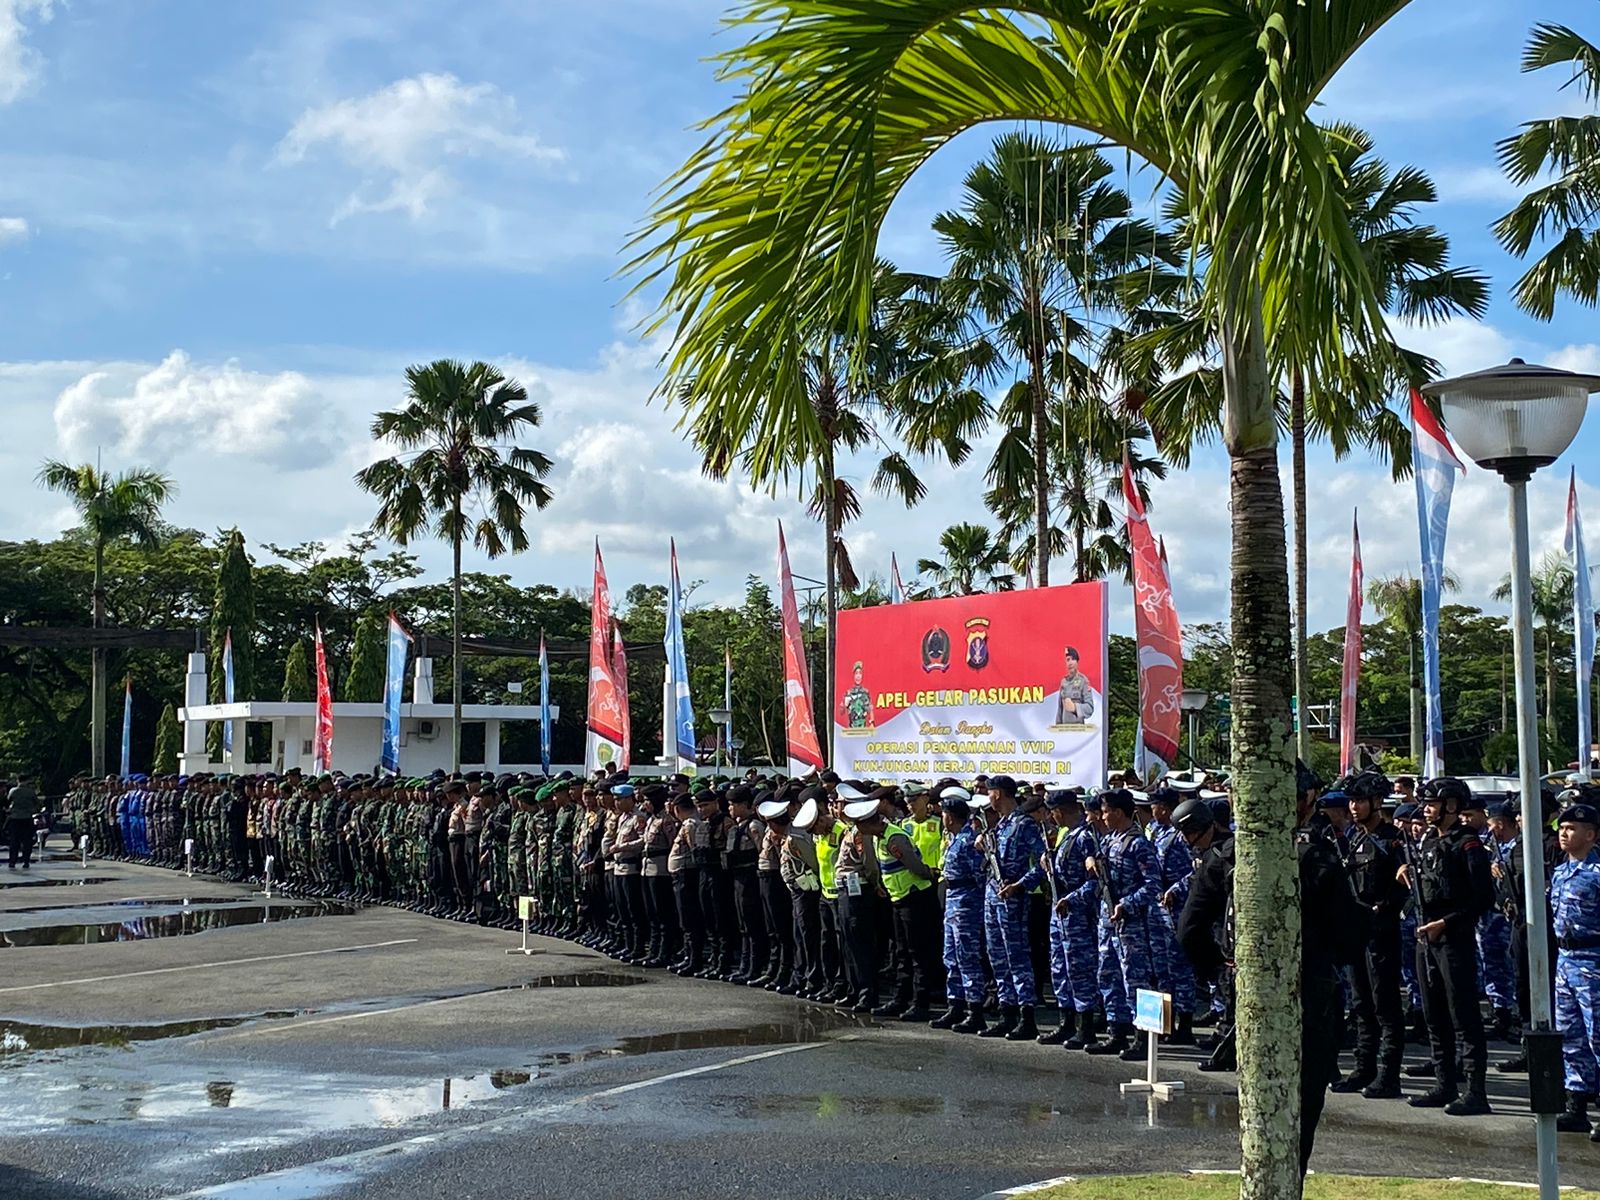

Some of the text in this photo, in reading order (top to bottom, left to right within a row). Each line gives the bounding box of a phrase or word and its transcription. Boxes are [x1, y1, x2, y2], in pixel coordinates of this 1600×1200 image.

[876, 686, 1044, 708] APEL GELAR PASUKAN
[866, 741, 1056, 754] OPERASI PENGAMANAN VVIP
[853, 760, 1072, 774] KUNJUNGAN KERJA PRESIDEN RI
